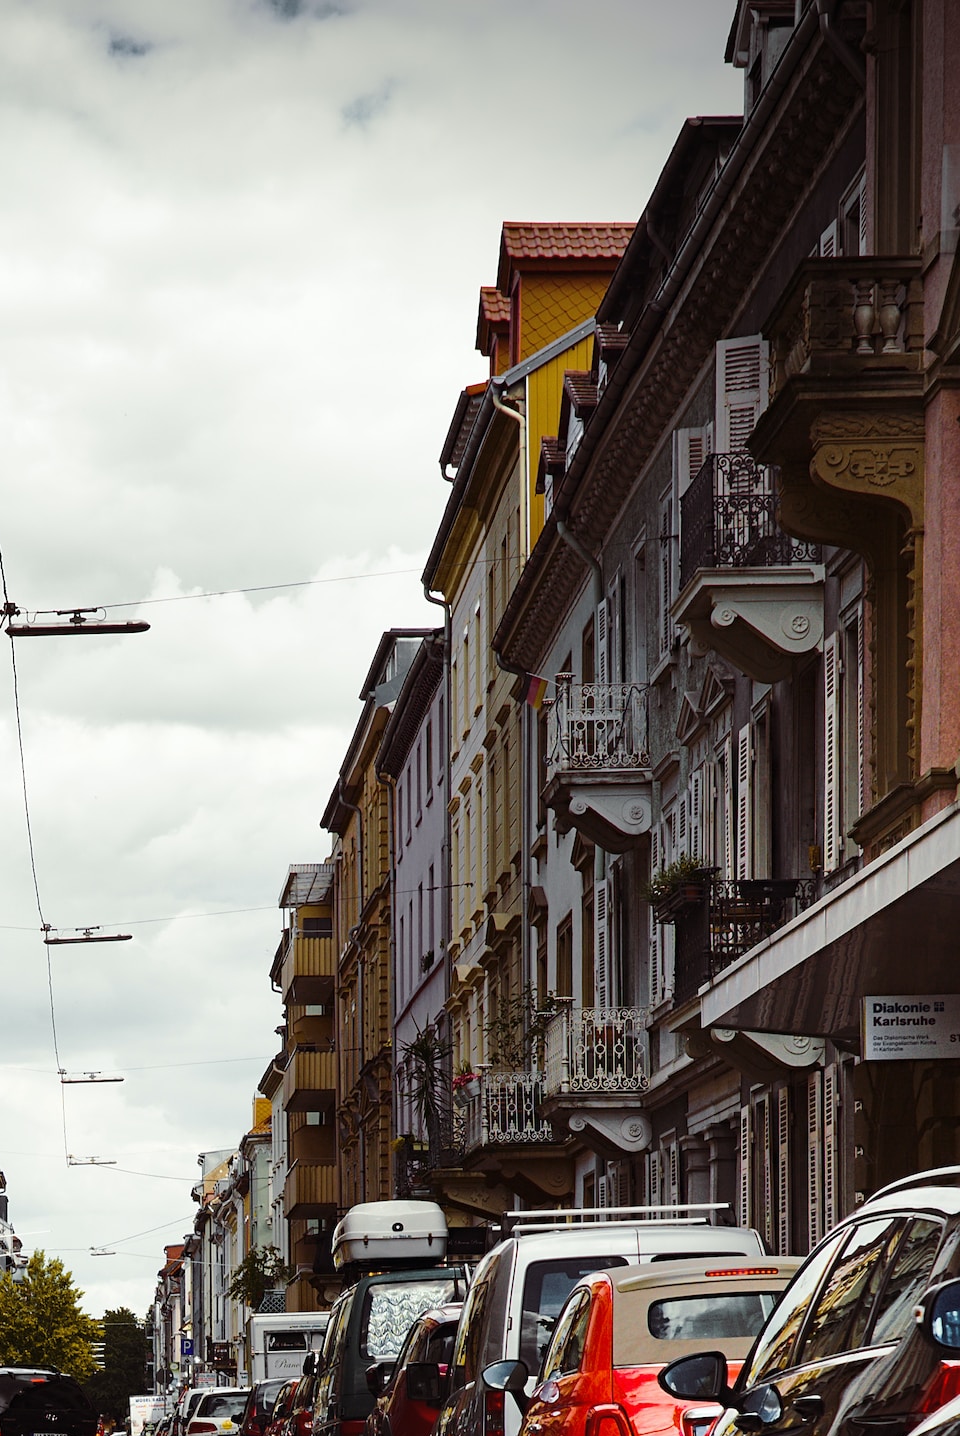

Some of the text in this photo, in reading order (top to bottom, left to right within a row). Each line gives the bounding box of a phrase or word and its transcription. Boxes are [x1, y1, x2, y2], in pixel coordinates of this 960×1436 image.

[872, 1002, 931, 1013] Diakonie
[873, 1015, 936, 1027] Karlsruhe
[183, 1340, 191, 1354] P
